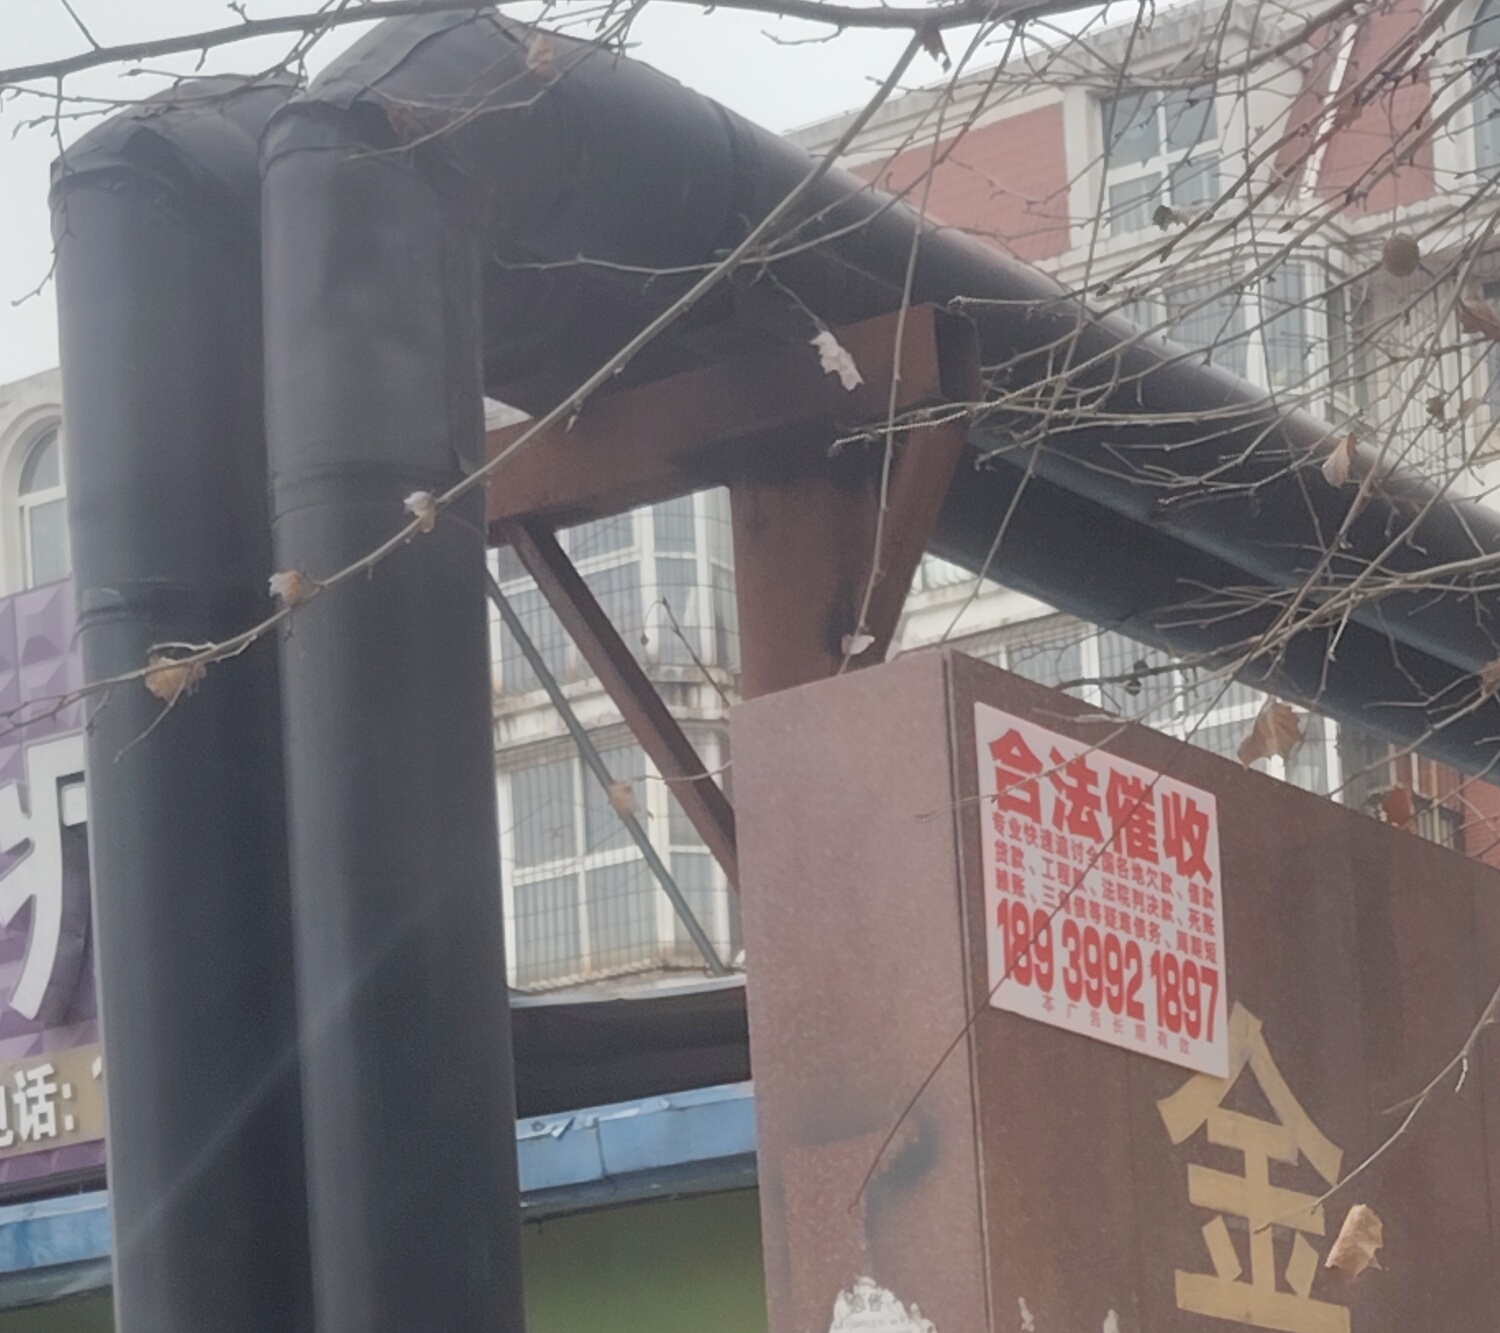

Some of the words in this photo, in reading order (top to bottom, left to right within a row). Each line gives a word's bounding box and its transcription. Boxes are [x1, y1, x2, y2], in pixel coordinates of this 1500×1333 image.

[987, 727, 1213, 884] 合法催收
[996, 899, 1054, 993] 189
[1061, 918, 1146, 1021] 3992
[1149, 949, 1219, 1044] 1897
